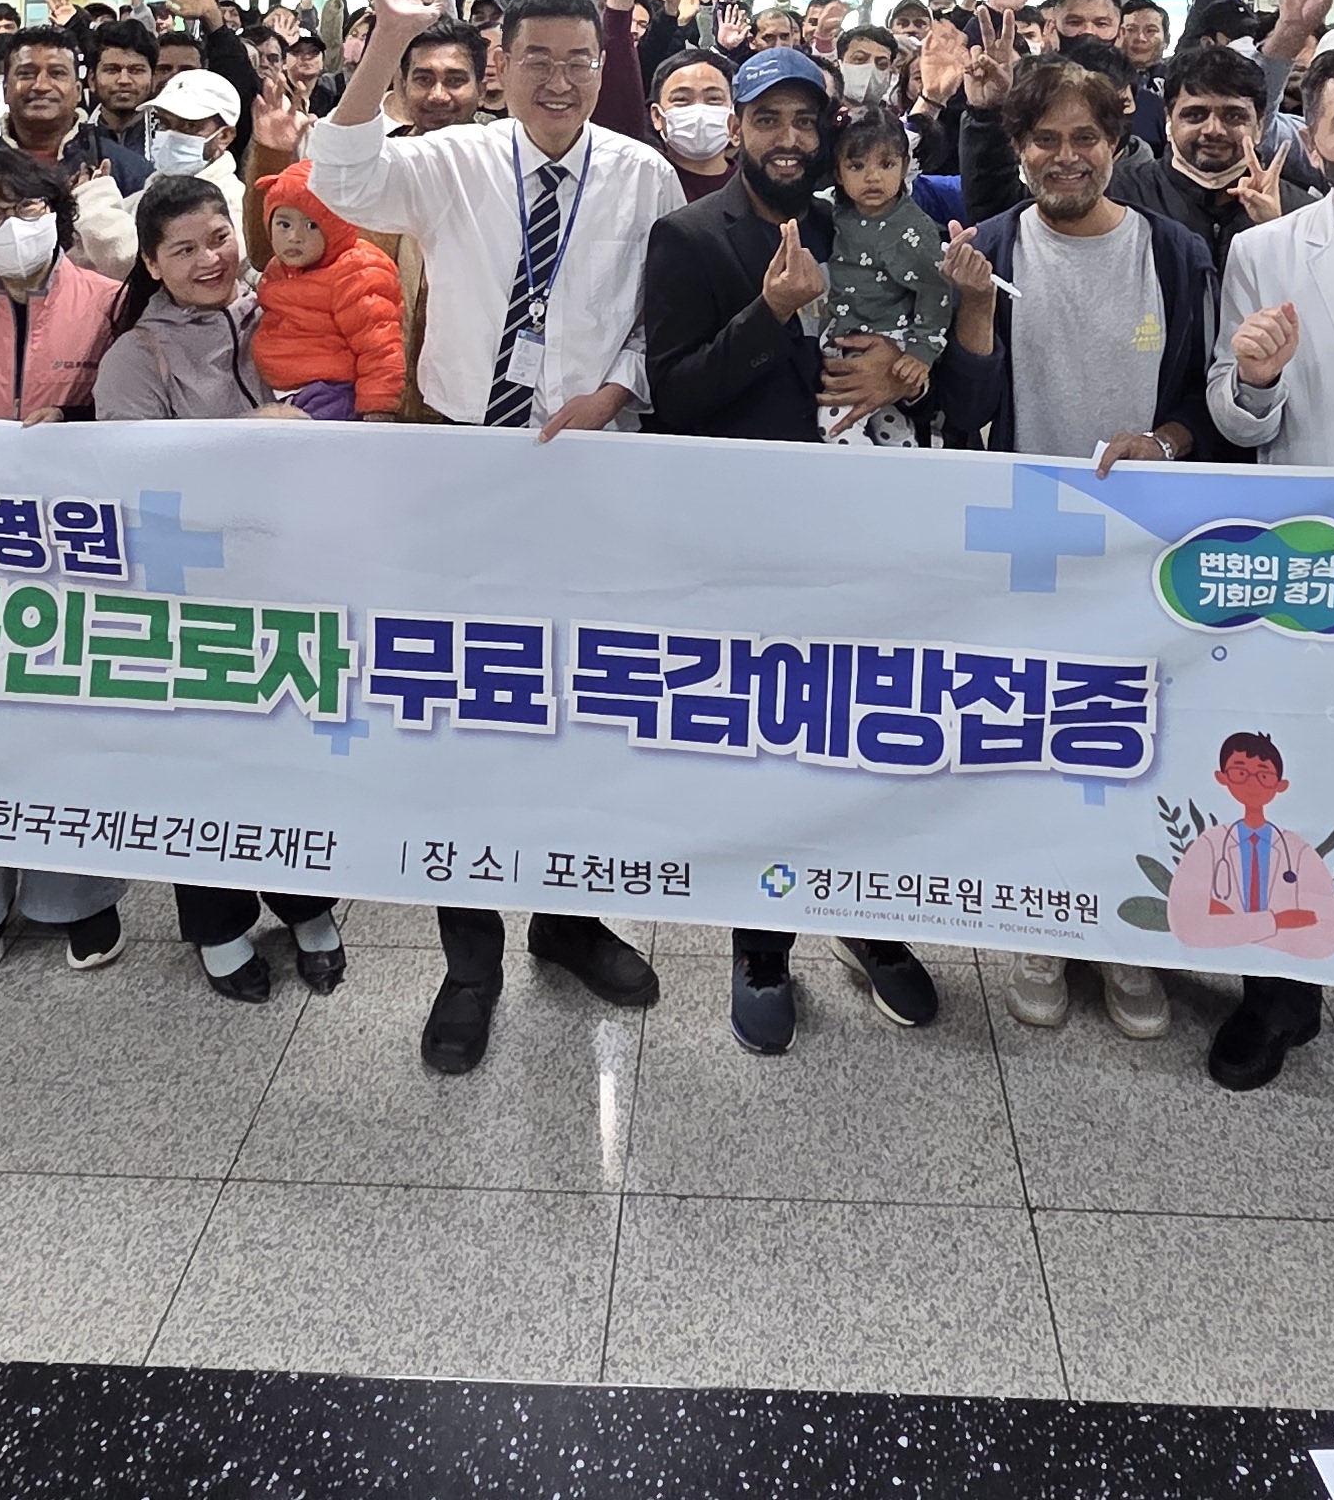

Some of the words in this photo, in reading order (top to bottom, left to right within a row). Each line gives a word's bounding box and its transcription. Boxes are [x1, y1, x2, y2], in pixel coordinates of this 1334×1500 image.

[1199, 552, 1279, 581] 변화의
[1199, 582, 1278, 608] 기회의
[369, 616, 549, 726] 무료
[572, 626, 1148, 770] 독감예방접종
[542, 851, 691, 896] 포천병원
[806, 868, 983, 915] 경기도의료원
[991, 884, 1099, 925] 포천병원
[804, 905, 852, 917] GYEONGGI
[854, 910, 905, 922] PROVINCIAL
[908, 914, 946, 926] MEDICAL
[950, 917, 984, 929] CENTER
[999, 922, 1042, 935] POCHEON
[1044, 928, 1086, 941] HOSPITAL
